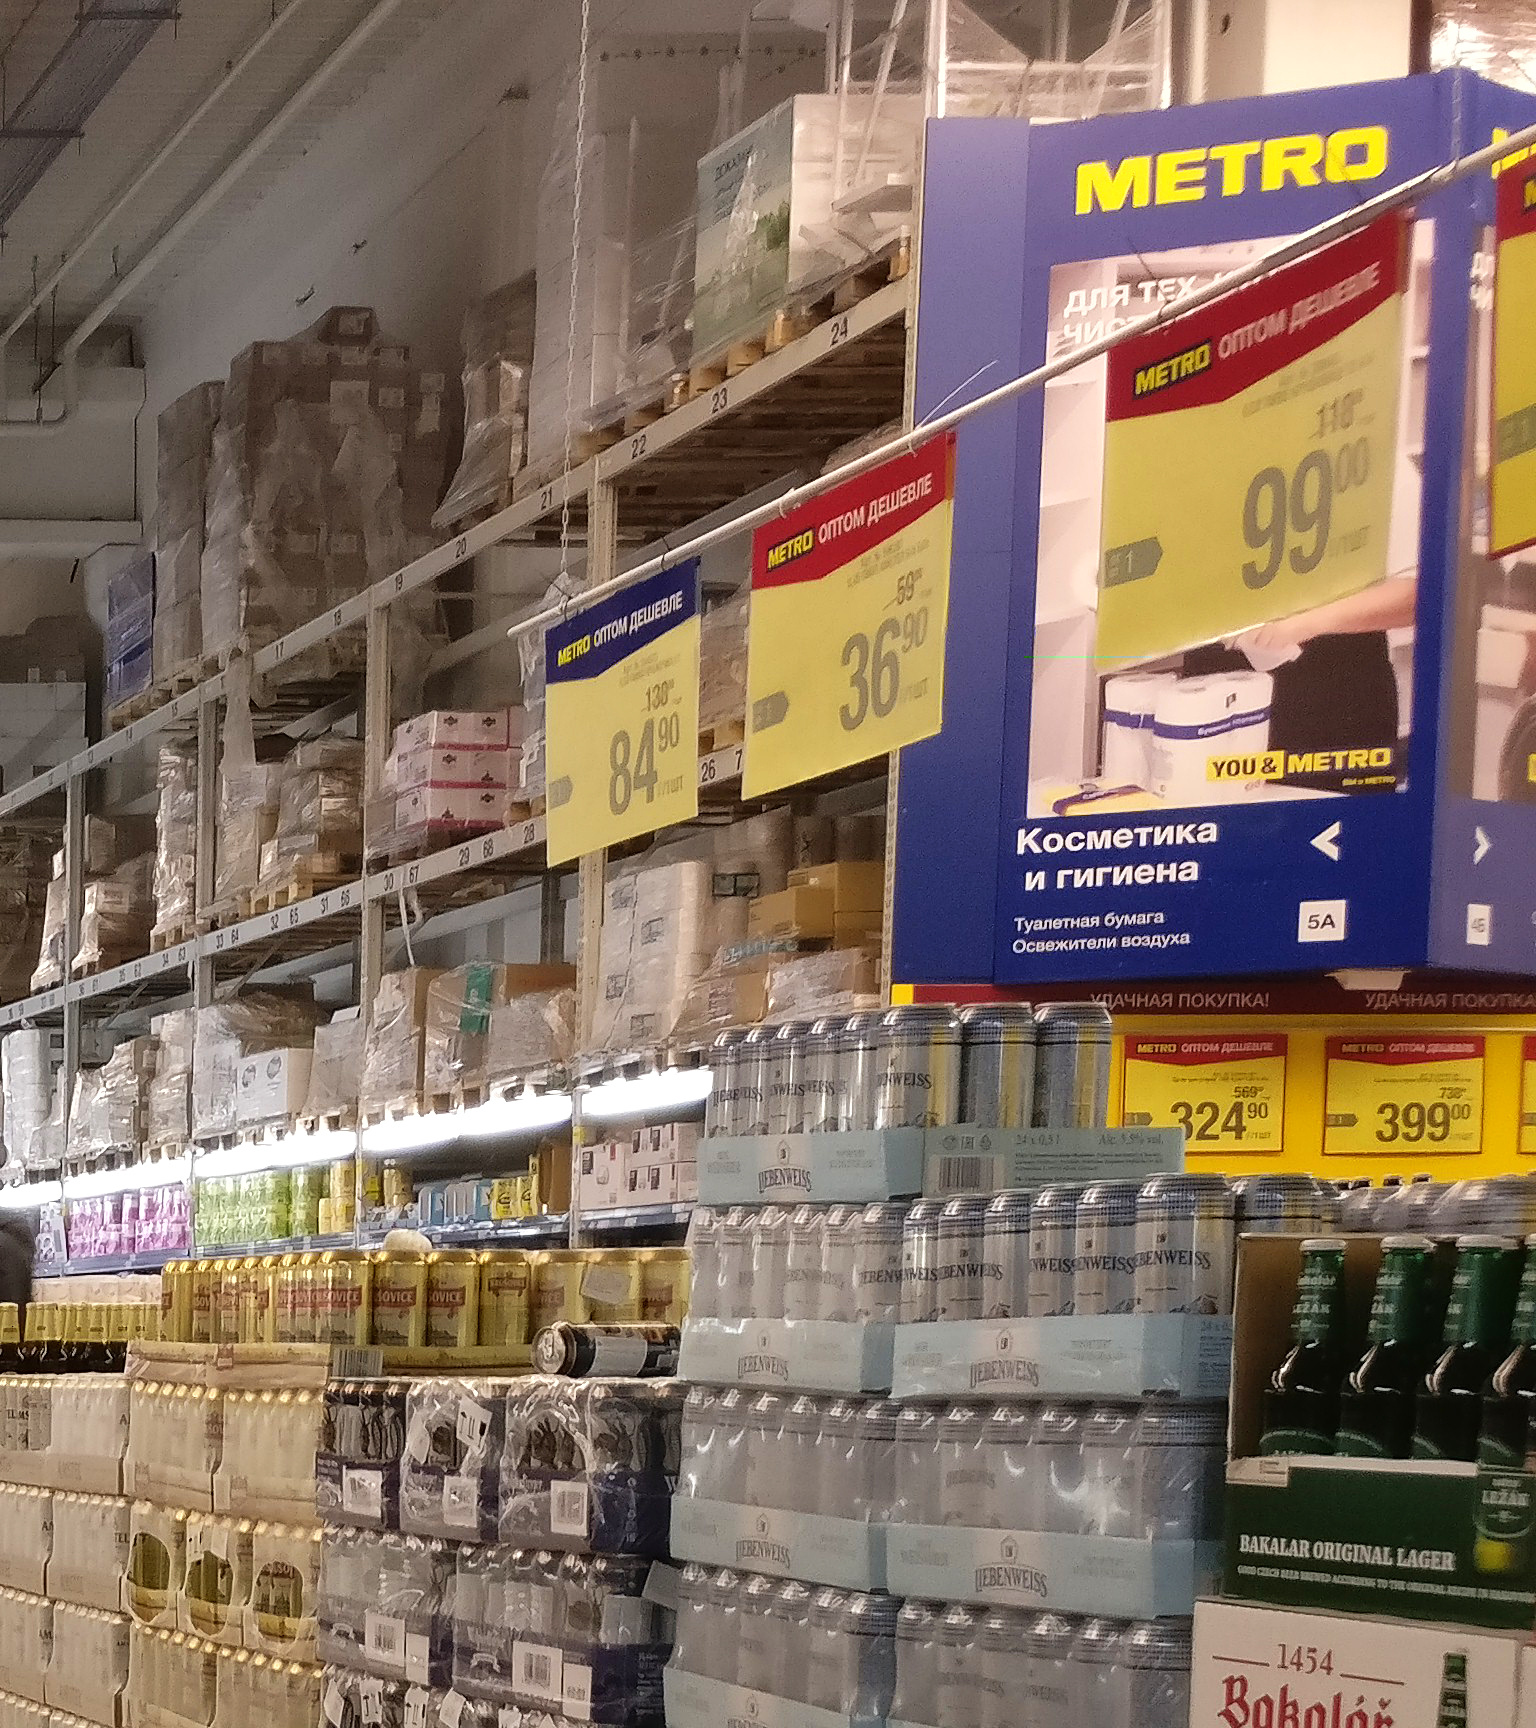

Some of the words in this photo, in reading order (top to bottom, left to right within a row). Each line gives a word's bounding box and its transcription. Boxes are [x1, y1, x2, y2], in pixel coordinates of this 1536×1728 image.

[1074, 124, 1390, 216] METRO
[1063, 283, 1130, 318] ДЛЯ
[830, 317, 849, 346] 24
[1134, 341, 1211, 396] METRO
[1217, 308, 1287, 359] ОПТОМ
[1288, 261, 1382, 337] ДЕШЕВЛЕ
[710, 389, 729, 414] 23
[631, 434, 648, 459] 22
[540, 489, 553, 511] 21
[1241, 448, 1333, 590] 99
[1333, 435, 1370, 495] 00
[766, 530, 814, 570] METRO
[817, 505, 865, 544] ОПТОМ
[866, 472, 933, 527] ДЕШЕВЛЕ
[454, 537, 467, 559] 20
[556, 634, 591, 667] METRO
[592, 617, 628, 649] ОПТОМ
[628, 589, 684, 636] ДЕШЕВЛЕ
[838, 616, 901, 733] 36
[900, 604, 929, 652] 90
[609, 718, 658, 816] 84
[658, 713, 680, 753] 90
[700, 759, 716, 782] 26
[1212, 757, 1257, 779] YOU
[1260, 755, 1278, 774] &
[1286, 747, 1392, 774] METRO
[1015, 818, 1219, 857] Косметика
[408, 866, 420, 883] 67
[1024, 870, 1047, 892] и
[1056, 858, 1199, 891] гигиена
[1013, 914, 1101, 932] Туалетная
[1104, 909, 1165, 929] бумага
[1307, 914, 1336, 930] 5А
[1012, 935, 1118, 955] Освежители
[1120, 931, 1191, 951] воздуха
[1090, 993, 1174, 1011] УДАЧНАЯ
[1176, 992, 1270, 1009] ПОКУПКА!
[1364, 993, 1447, 1012] УДАЧНАЯ
[1136, 1043, 1177, 1053] METRO
[1181, 1042, 1219, 1053] ОПТОМ
[1221, 1041, 1274, 1053] ДЕШЕВЛЕ
[1170, 1100, 1246, 1141] 324
[1246, 1101, 1269, 1120] 90
[1375, 1100, 1451, 1143] 399
[1450, 1103, 1472, 1121] 00
[1238, 1533, 1310, 1560] BAKALAR
[1312, 1539, 1394, 1566] ORIGINAL
[1396, 1547, 1456, 1572] LAGER
[1276, 1642, 1335, 1677] 1454
